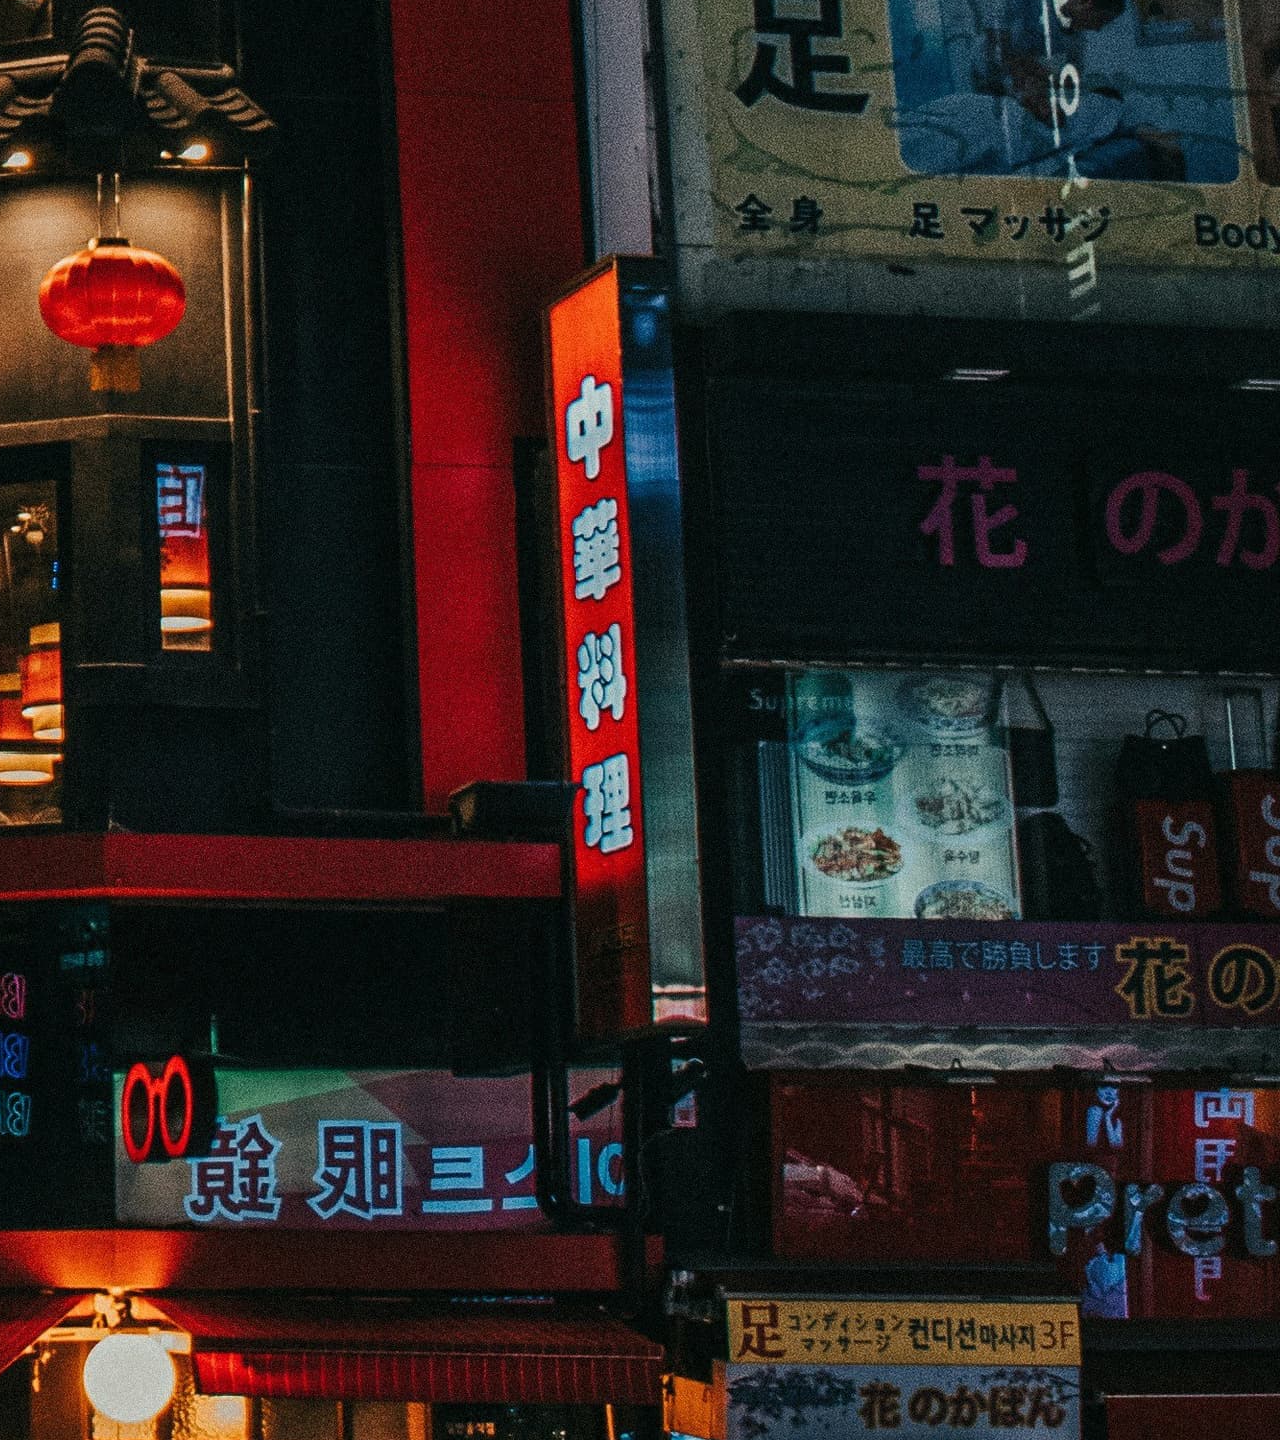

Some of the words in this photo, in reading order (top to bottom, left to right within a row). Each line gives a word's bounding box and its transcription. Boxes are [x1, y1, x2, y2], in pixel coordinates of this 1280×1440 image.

[735, 193, 823, 236] 全身
[900, 939, 1107, 973] 最高で勝負します
[737, 1303, 787, 1360] 足
[907, 1317, 979, 1352] 컨디션
[980, 1324, 1036, 1352] 마사지
[1039, 1320, 1075, 1351] 3F
[859, 1382, 1066, 1430] 花のかばん
